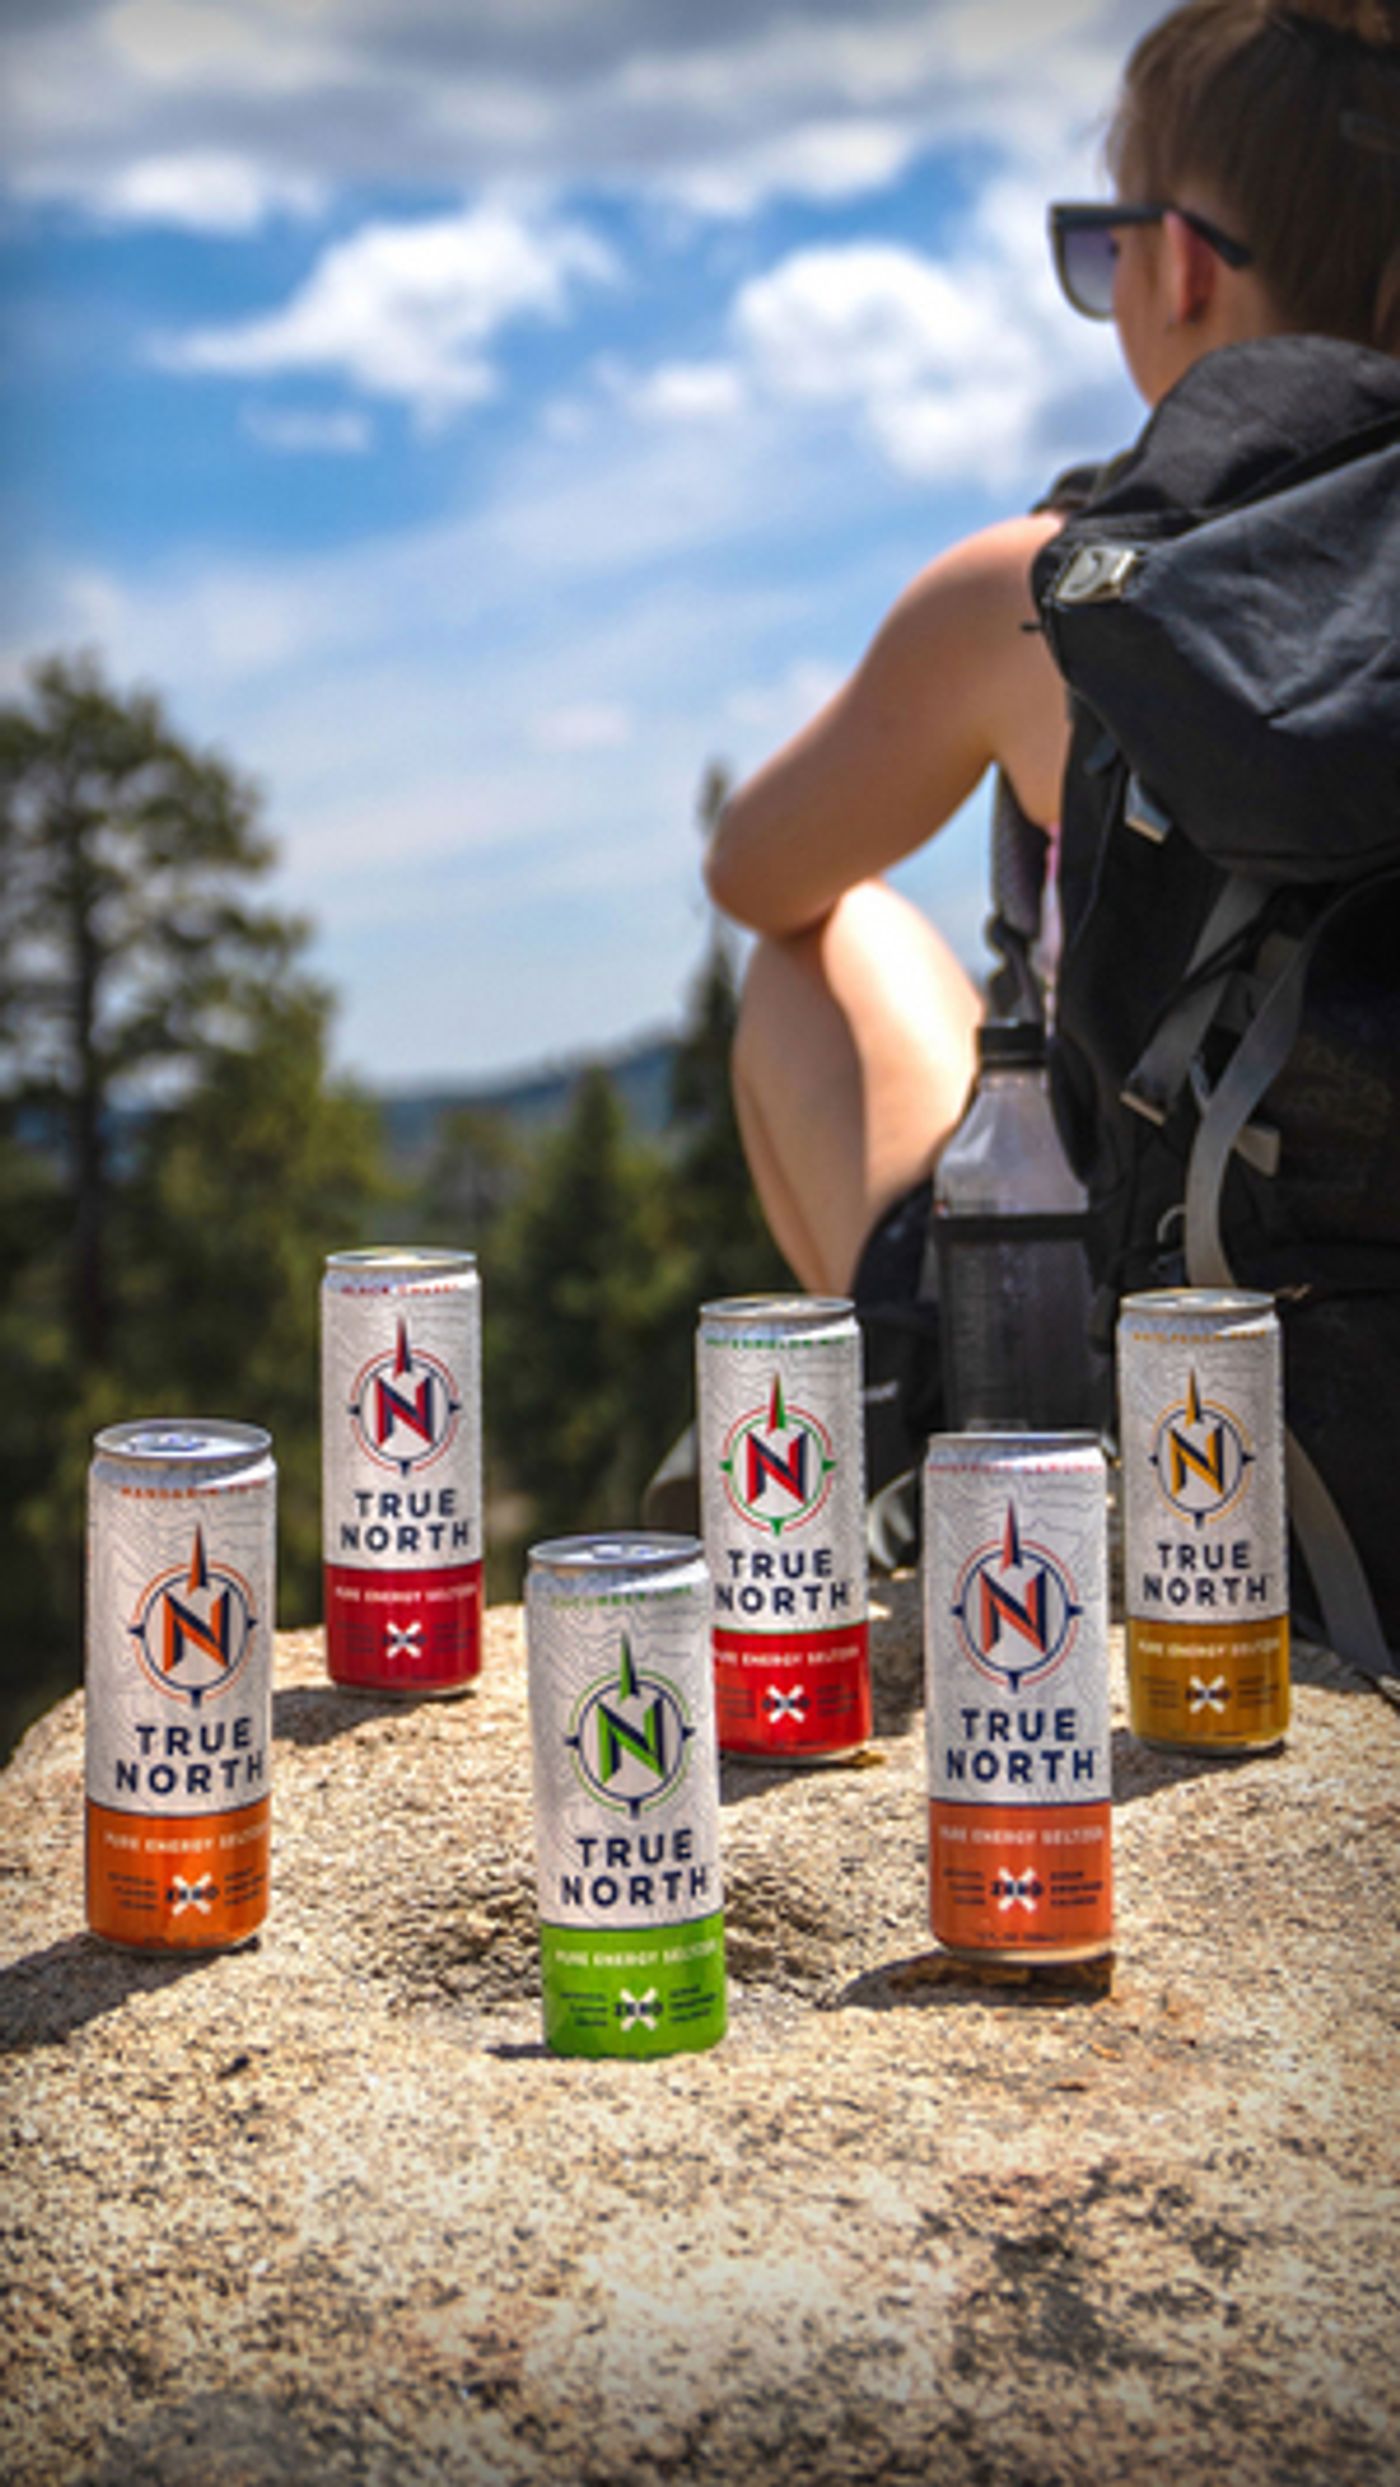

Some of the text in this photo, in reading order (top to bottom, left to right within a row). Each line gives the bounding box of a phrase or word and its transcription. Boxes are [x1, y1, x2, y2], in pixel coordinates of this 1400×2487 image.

[354, 1489, 456, 1518] TRUE
[340, 1521, 469, 1552] NORTH
[727, 1549, 832, 1579] TRUE
[1156, 1542, 1251, 1571] TRUE
[714, 1582, 848, 1615] NORTH
[1143, 1576, 1267, 1606] NORTH
[135, 1717, 252, 1756] TRUE
[961, 1709, 1076, 1742] TRUE
[116, 1752, 264, 1795] NORTH
[946, 1748, 1094, 1783] NORTH
[576, 1829, 692, 1868] TRUE
[561, 1867, 707, 1906] NORTH
